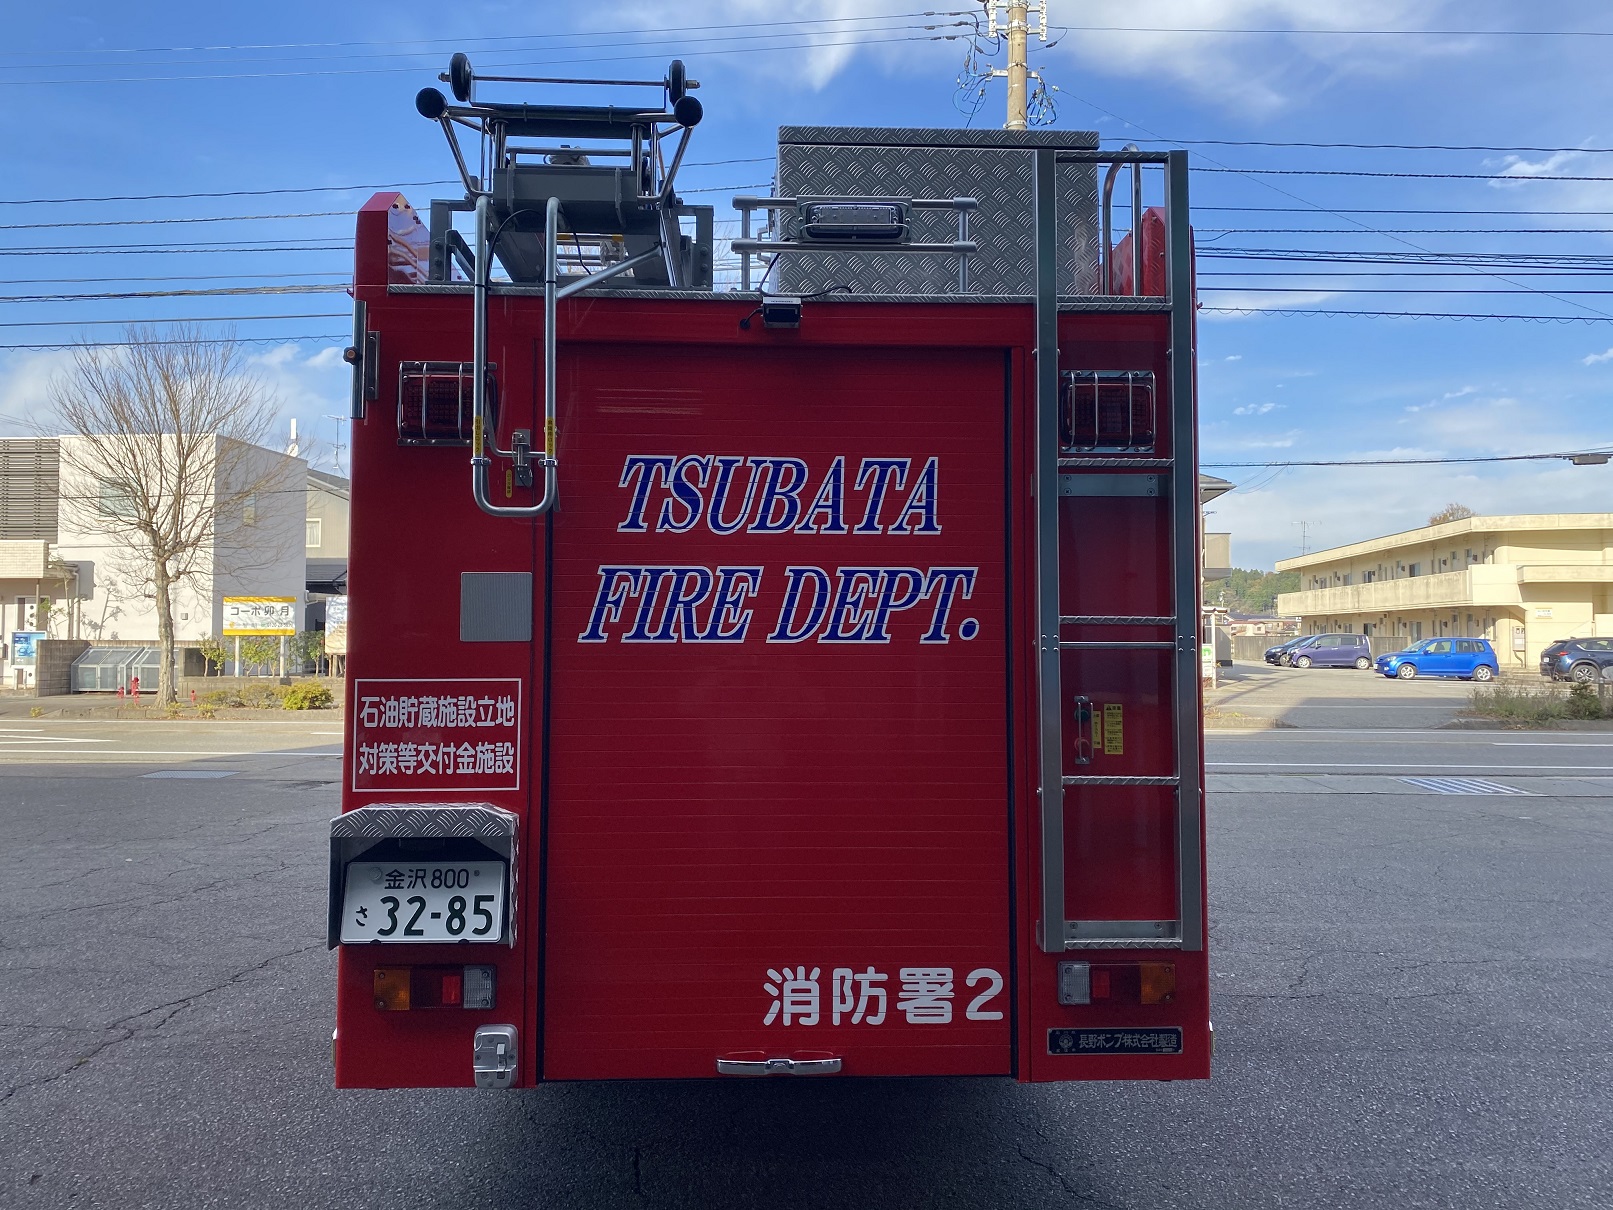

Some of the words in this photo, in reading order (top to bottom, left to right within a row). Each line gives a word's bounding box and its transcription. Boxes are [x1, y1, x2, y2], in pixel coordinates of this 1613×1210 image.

[616, 454, 943, 536] TSUBATA
[577, 564, 764, 644] FIRE
[765, 565, 980, 645] DEPT.
[359, 694, 515, 729] 石油貯蔵施設立地
[358, 741, 515, 776] 対策等交付金施設
[355, 905, 368, 927] さ
[376, 894, 495, 937] 32-85
[762, 965, 1005, 1027] 消防署2
[1078, 1032, 1178, 1048] 長野ポンプ株式会社製造
